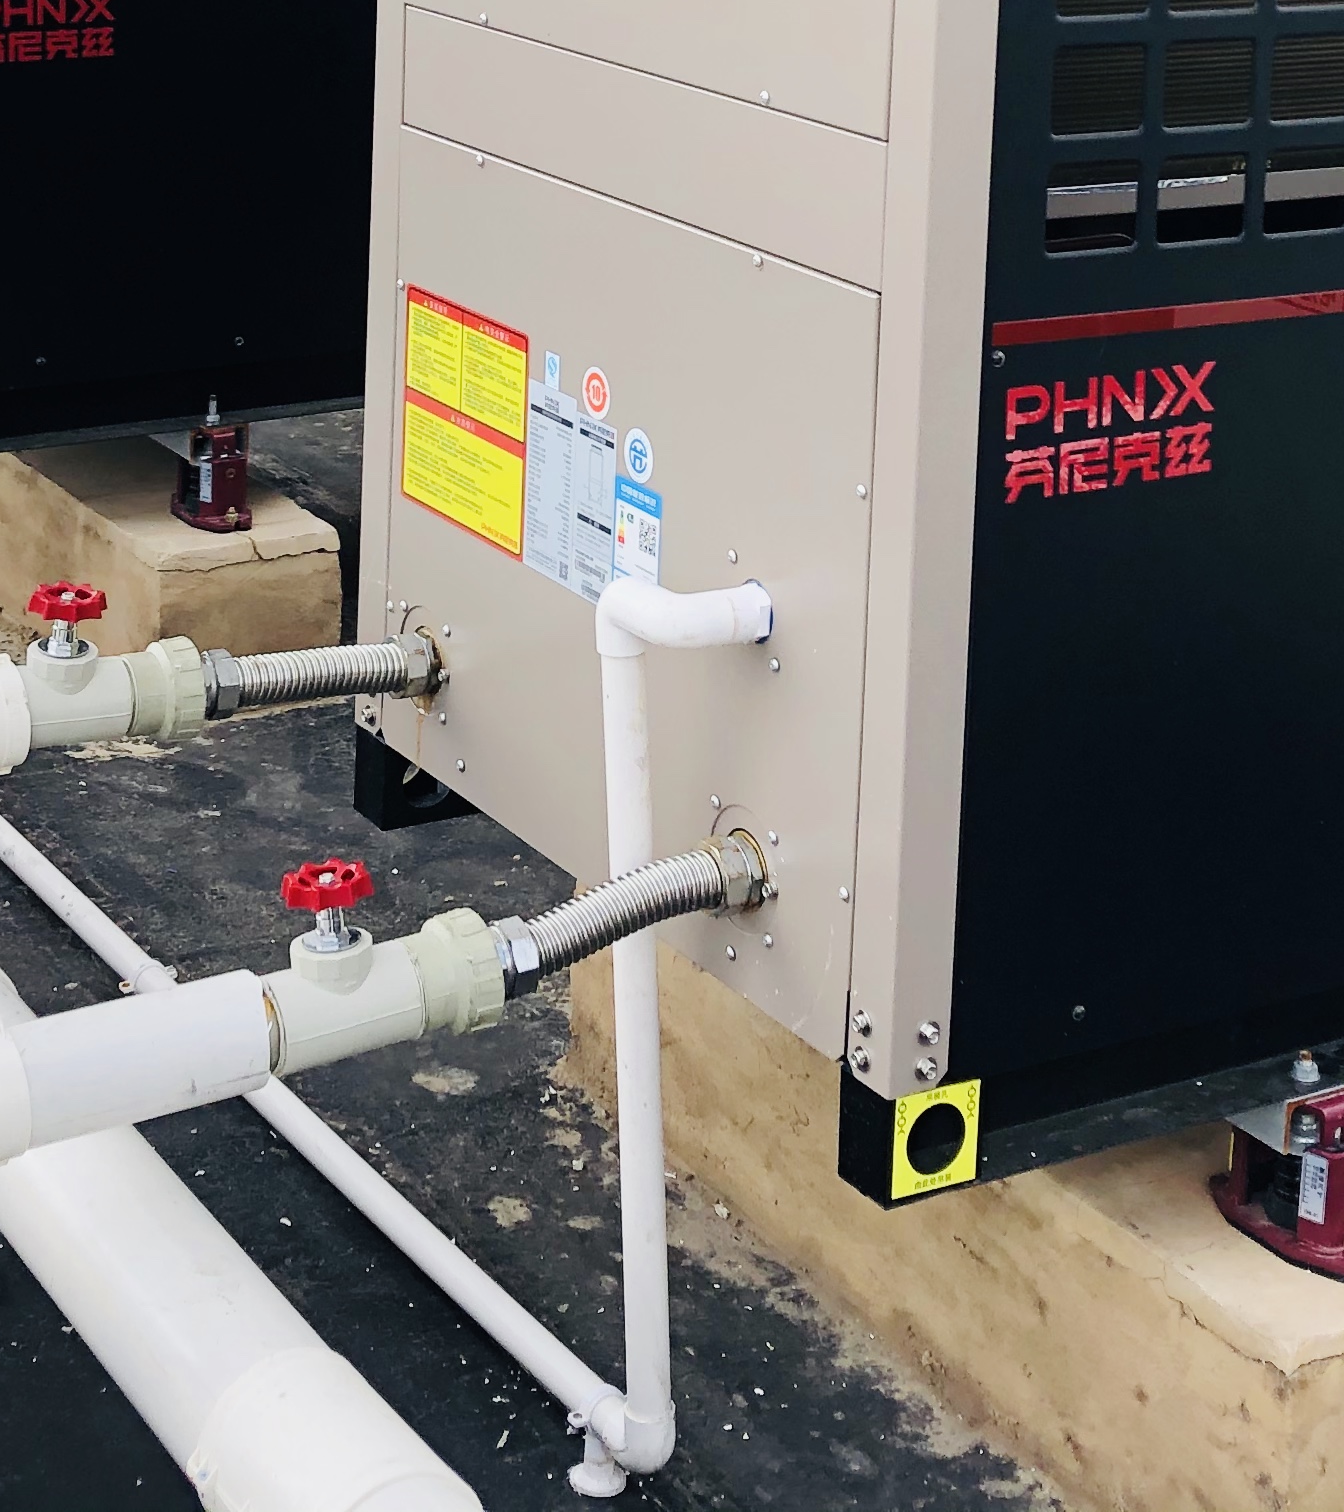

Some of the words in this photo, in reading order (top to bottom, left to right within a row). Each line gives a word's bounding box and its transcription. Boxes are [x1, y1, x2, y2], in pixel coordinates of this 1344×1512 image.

[592, 385, 601, 402] 10
[1005, 422, 1212, 503] 芬尼克兹
